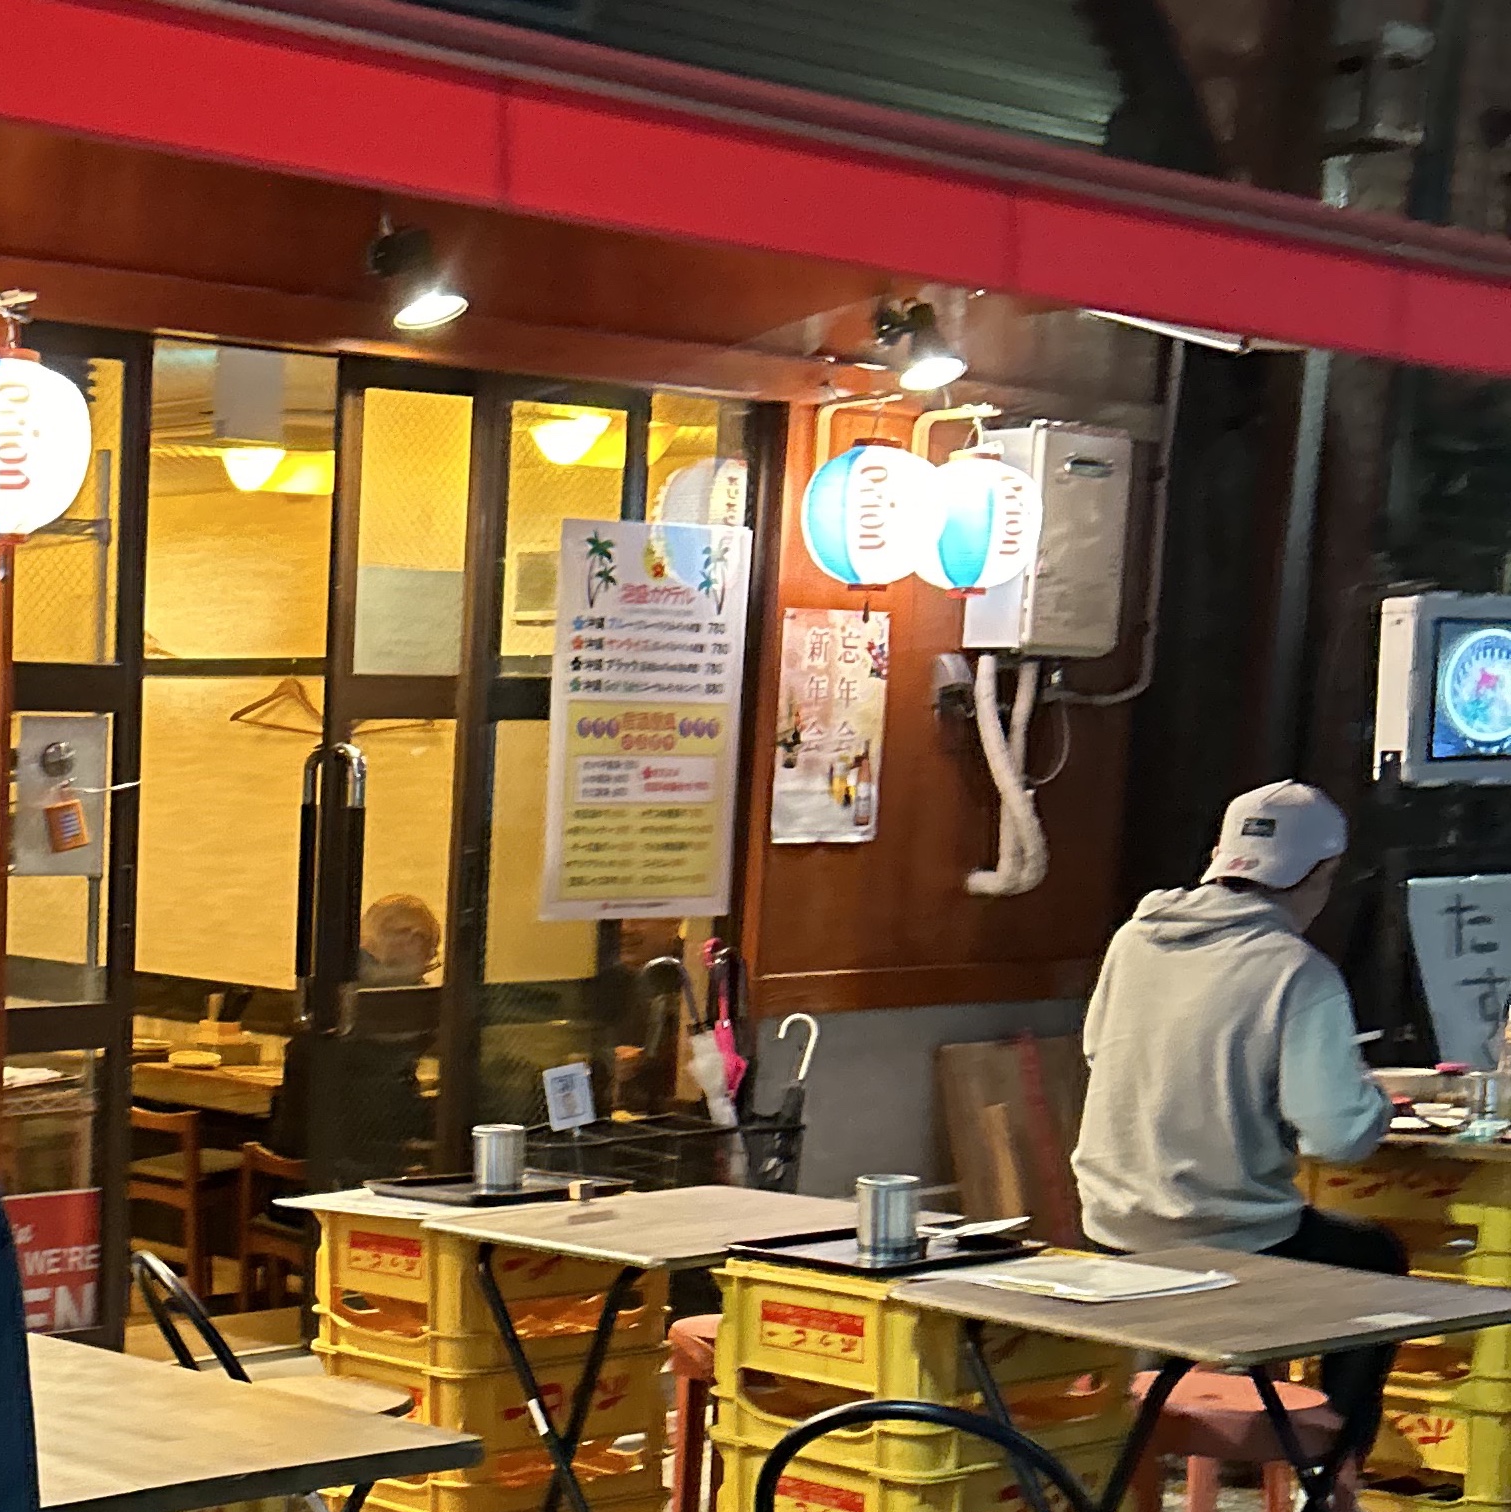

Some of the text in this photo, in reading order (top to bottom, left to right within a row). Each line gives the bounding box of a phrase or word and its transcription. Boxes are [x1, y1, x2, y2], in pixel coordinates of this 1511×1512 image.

[858, 465, 895, 550] Orion
[999, 476, 1031, 555] Orion
[800, 627, 833, 752] 新年会
[829, 626, 862, 753] 忘年会
[23, 1281, 98, 1332] EN
